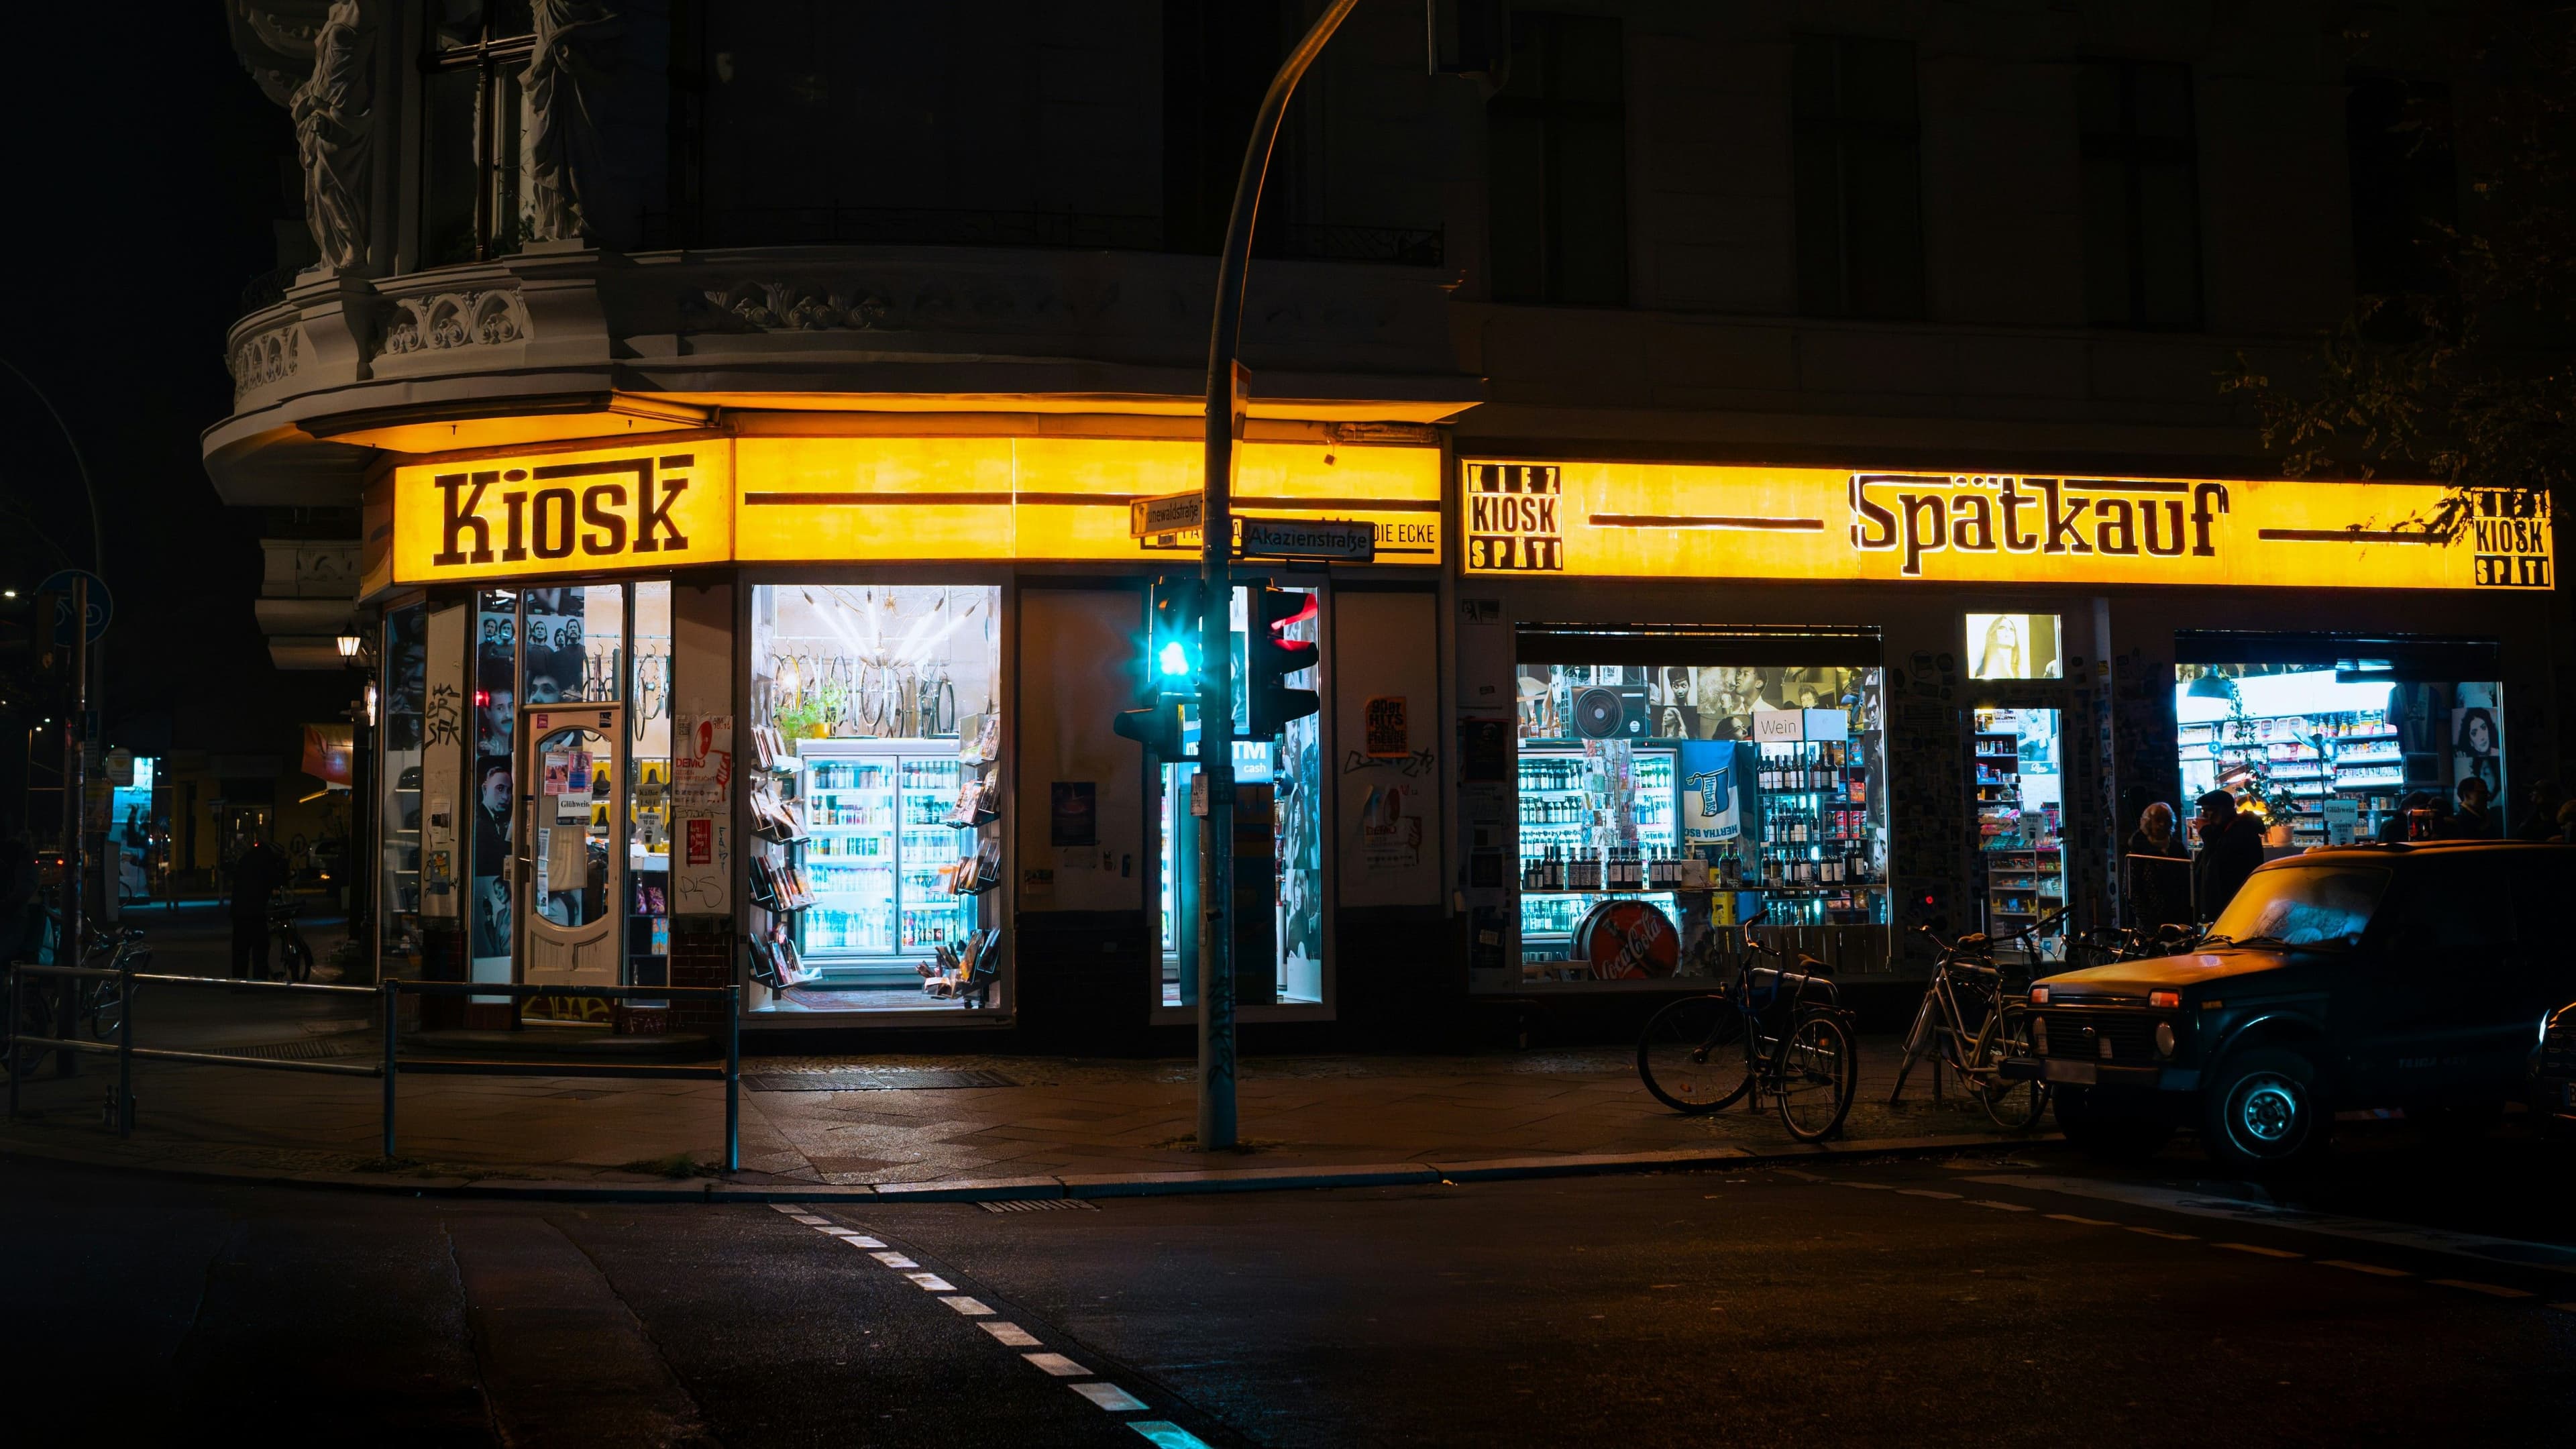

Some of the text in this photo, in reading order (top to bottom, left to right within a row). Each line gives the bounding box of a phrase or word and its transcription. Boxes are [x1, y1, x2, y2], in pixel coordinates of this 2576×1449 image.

[1470, 466, 1556, 494] KIEZ
[433, 453, 694, 566] Kiosk
[1472, 496, 1556, 533] KIOSK
[1399, 524, 1434, 543] ECKE
[1849, 474, 2231, 575] Spätkauf
[2476, 520, 2544, 553] KIOSK
[1247, 526, 1367, 553] Akazienstraße
[1472, 536, 1562, 569] SPÄTI
[2476, 556, 2549, 584] SPÄTI
[1760, 719, 1796, 735] Wein
[676, 758, 706, 768] DEMO
[1232, 741, 1267, 759] TM
[1243, 762, 1267, 773] cash
[561, 800, 590, 808] Glühwein
[1703, 824, 1739, 839] HERTHA
